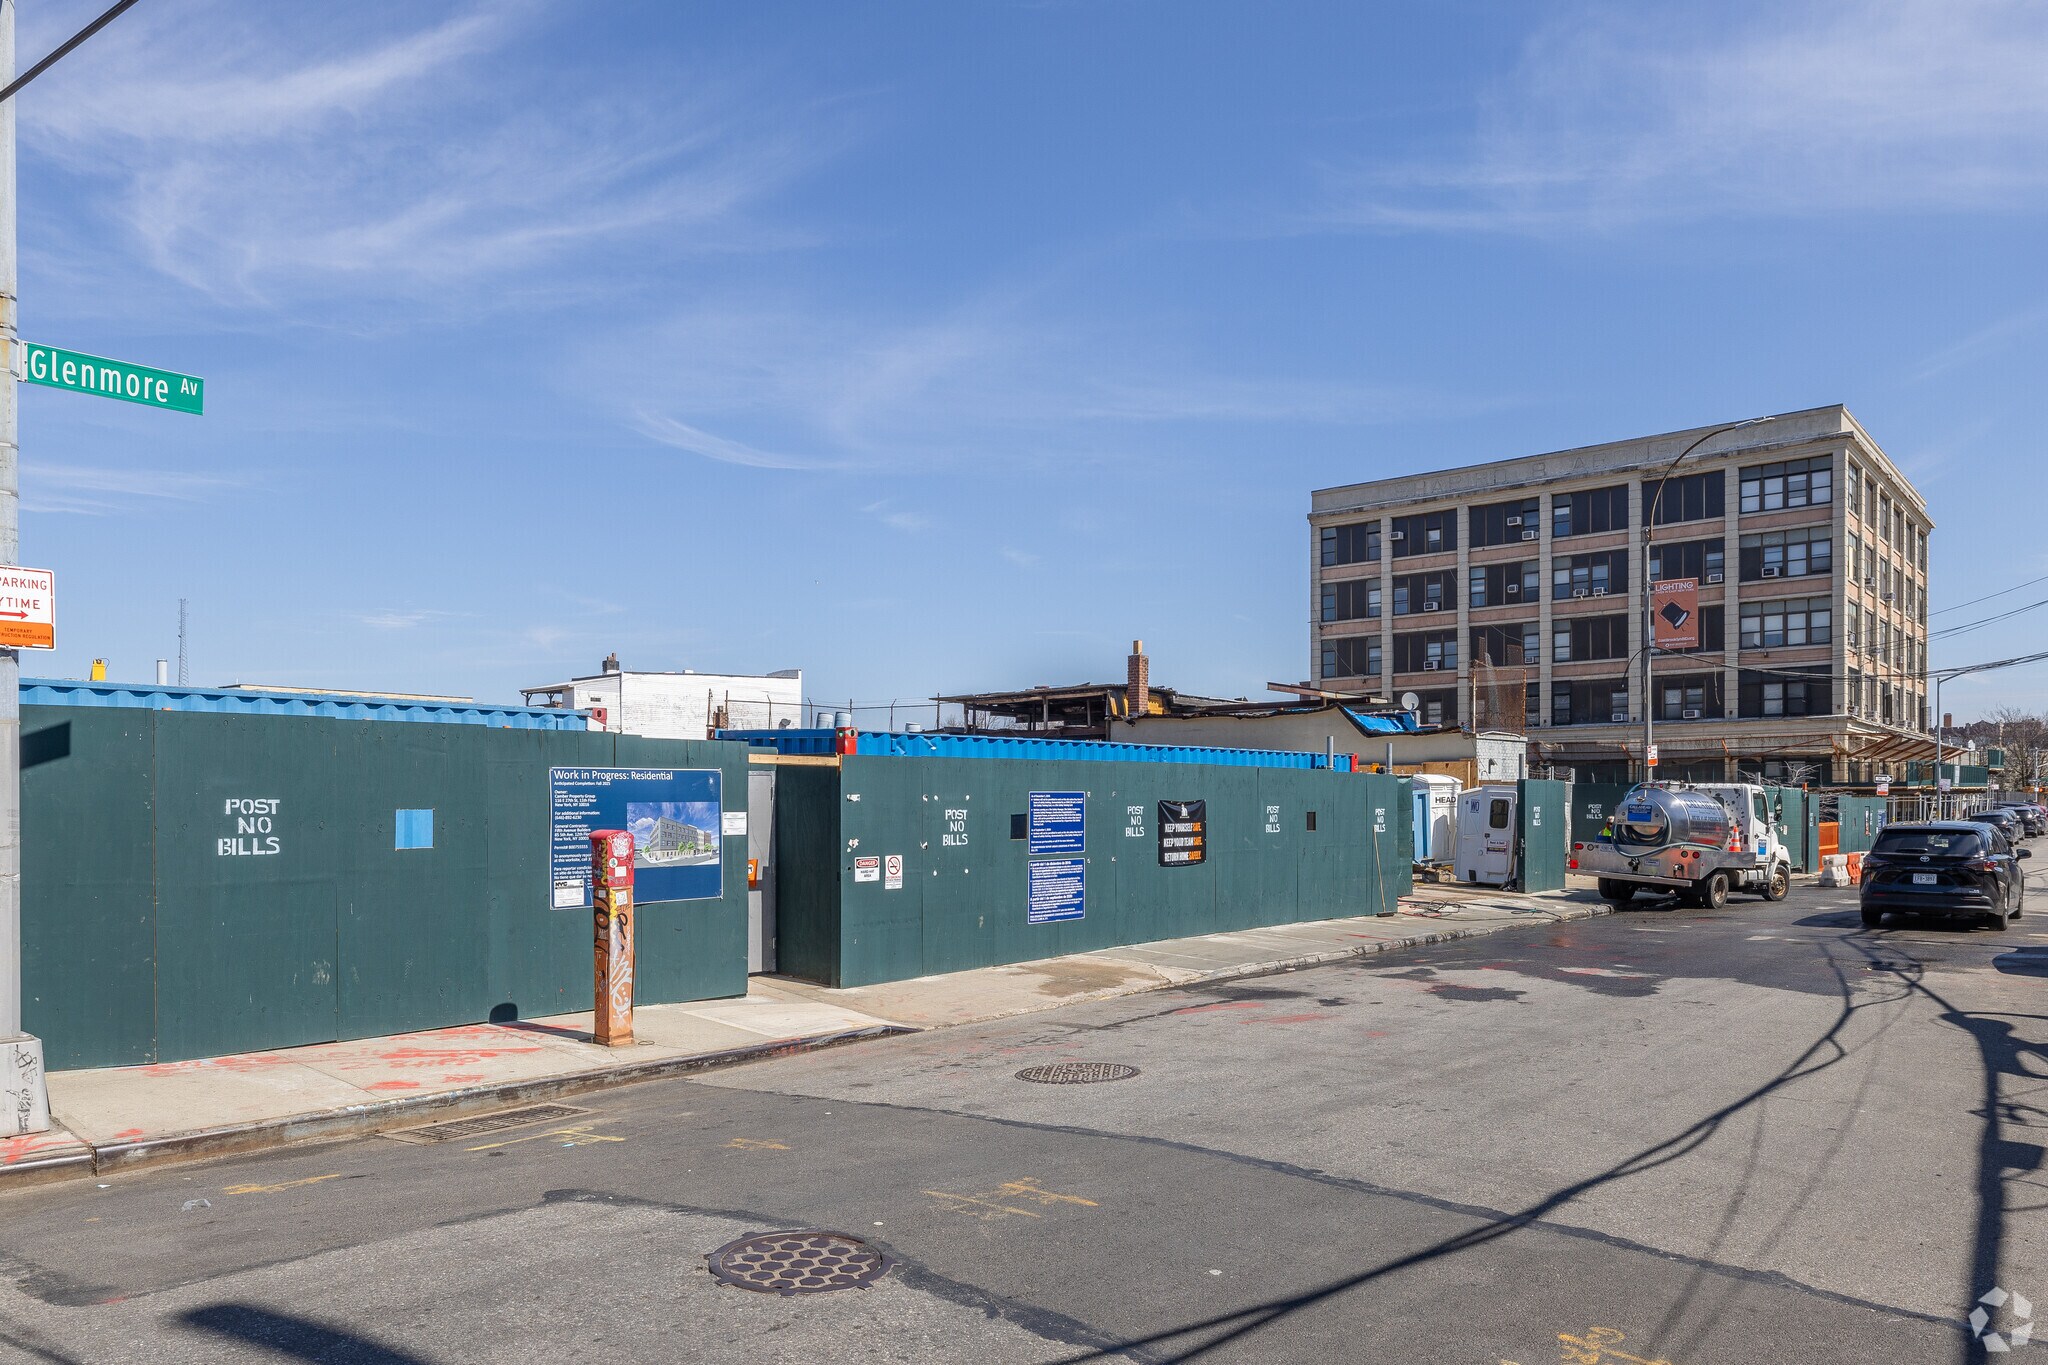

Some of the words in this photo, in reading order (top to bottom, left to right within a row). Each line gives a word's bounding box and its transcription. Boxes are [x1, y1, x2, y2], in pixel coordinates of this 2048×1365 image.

[31, 350, 168, 402] Glenmore
[181, 378, 198, 396] Av
[1656, 582, 1694, 592] LIGHTING
[554, 771, 579, 779] Work
[581, 771, 589, 779] in
[592, 771, 629, 781] Progress:
[631, 771, 673, 780] Residential
[226, 799, 280, 814] POST
[1128, 806, 1144, 815] POST
[945, 809, 968, 820] POST
[238, 817, 272, 833] NO
[1131, 816, 1141, 825] NO
[950, 821, 964, 832] NO
[1165, 824, 1174, 832] KEEP
[1175, 823, 1192, 832] YOURSELF
[1265, 824, 1280, 833] BILLS
[1374, 824, 1385, 832] BILLS
[1126, 827, 1144, 837] BILLS
[943, 834, 968, 846] BILLS
[1164, 838, 1173, 847] KEEP
[1174, 838, 1183, 847] YOUR
[1184, 838, 1194, 846] TEAM
[218, 837, 280, 855] BILLS
[1164, 852, 1179, 862] RETURN
[1180, 852, 1189, 860] HOME
